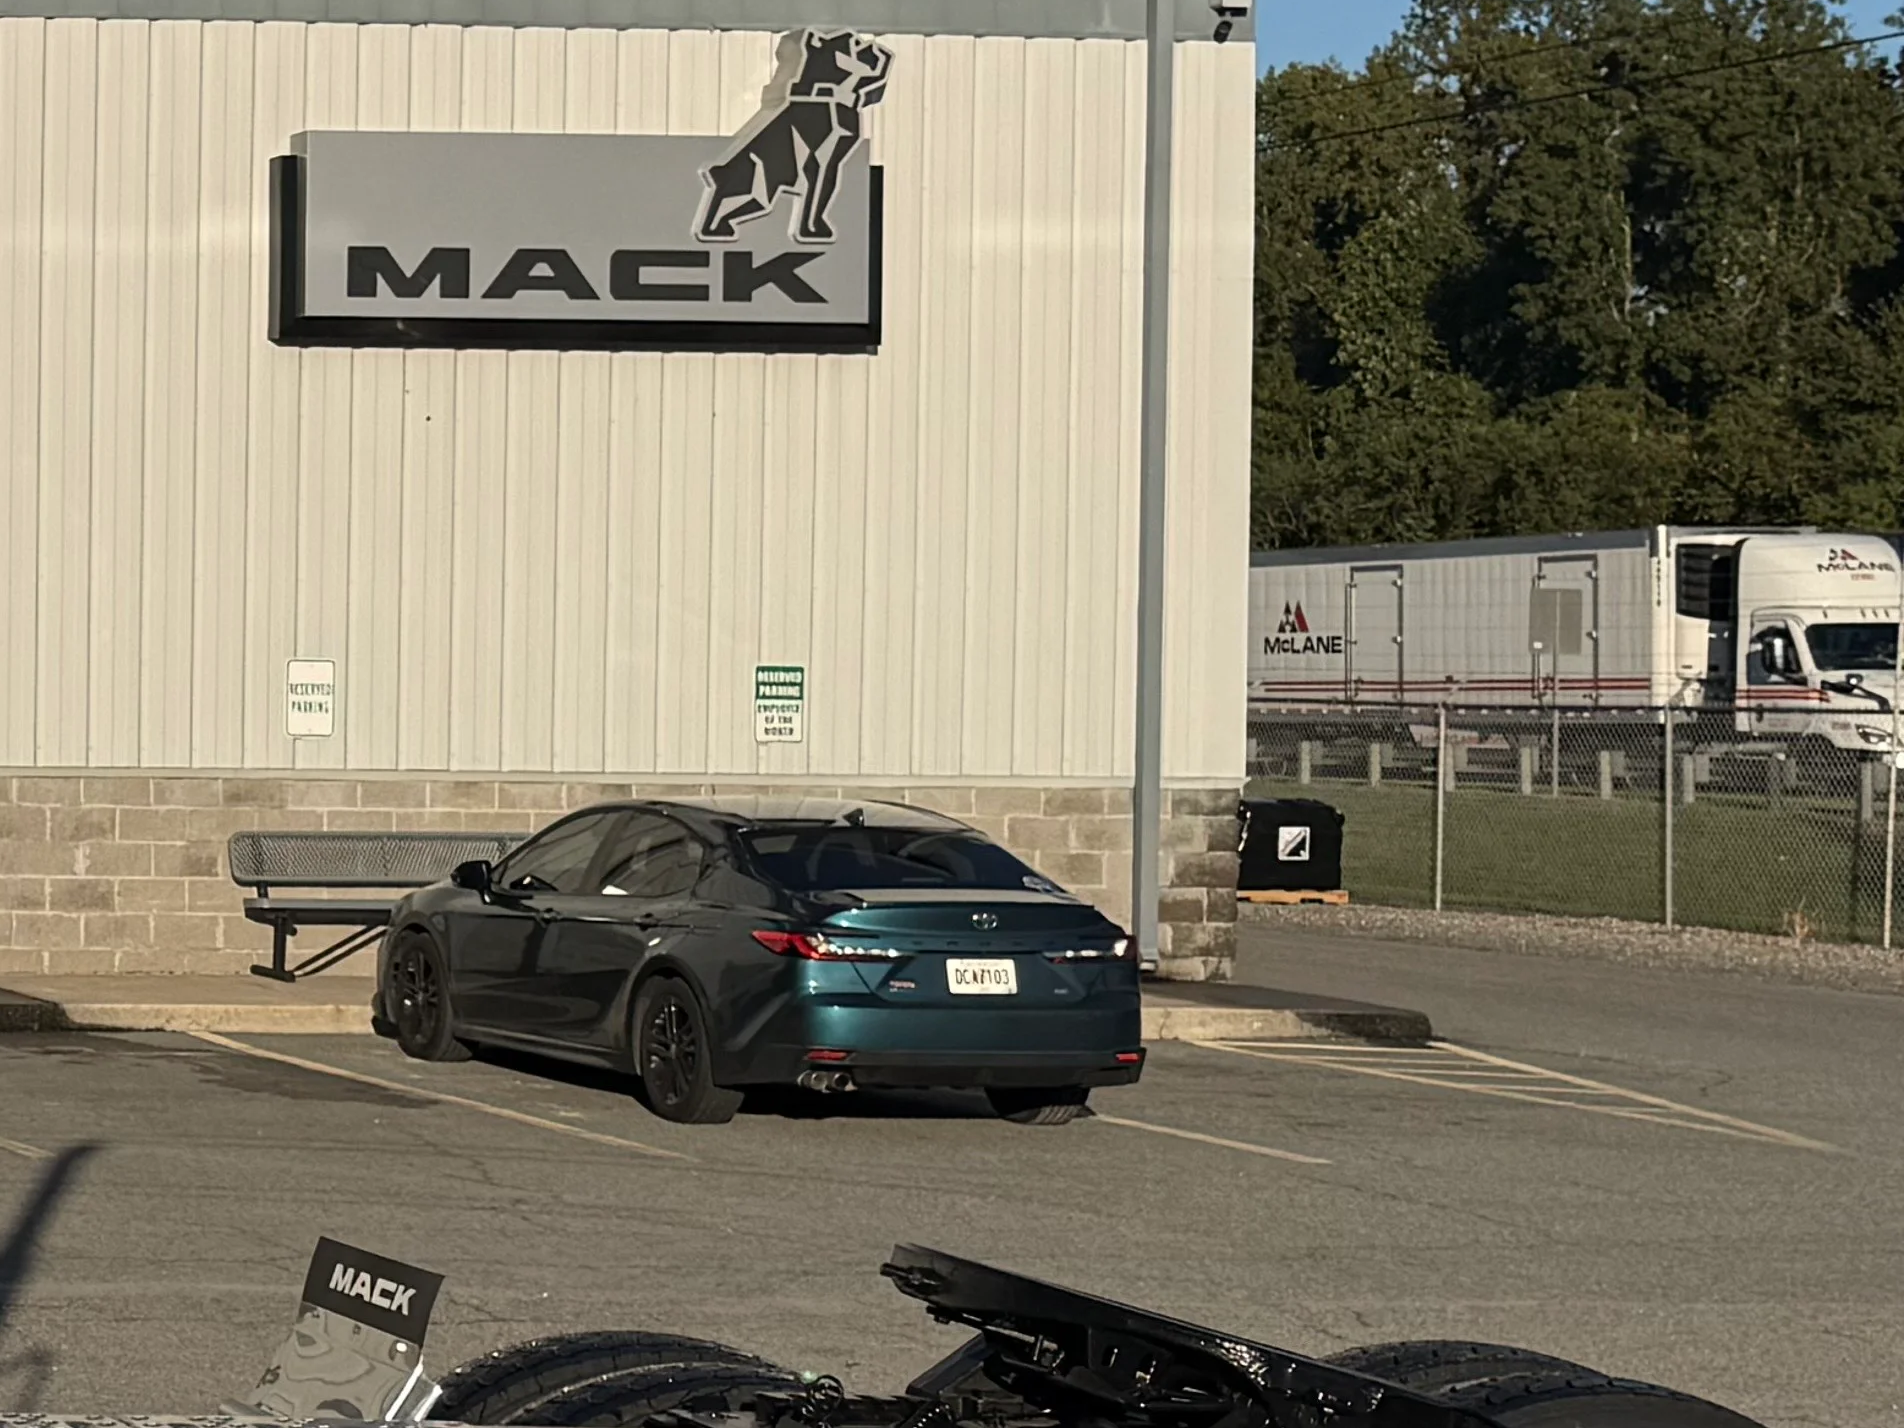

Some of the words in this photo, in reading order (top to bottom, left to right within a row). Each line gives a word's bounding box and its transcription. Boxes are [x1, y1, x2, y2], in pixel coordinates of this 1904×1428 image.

[347, 246, 829, 304] MACK
[1263, 636, 1343, 654] McLANE
[329, 1263, 417, 1316] MACK
